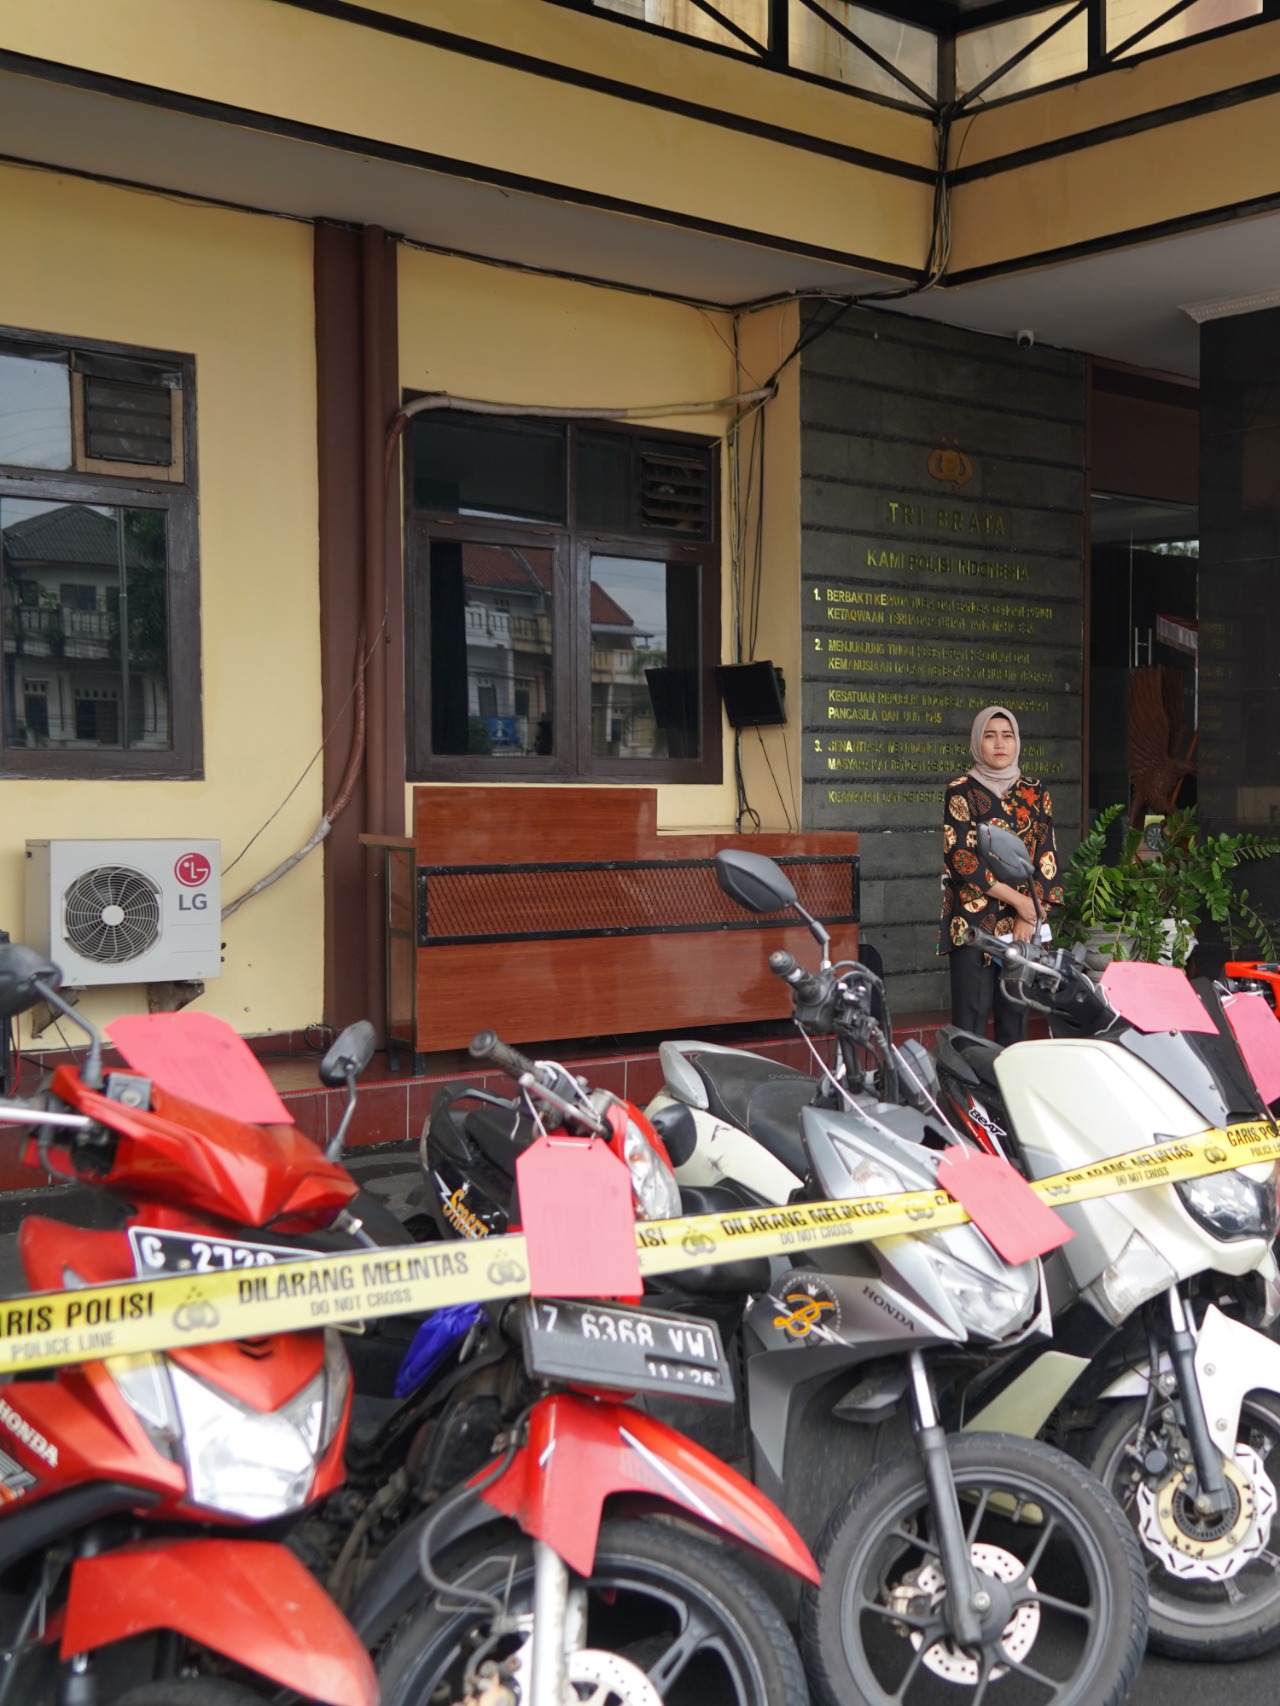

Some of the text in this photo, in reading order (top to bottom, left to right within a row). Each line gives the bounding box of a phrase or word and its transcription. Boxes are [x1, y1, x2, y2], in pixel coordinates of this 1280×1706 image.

[888, 501, 1006, 536] TRI BRATA
[866, 548, 1030, 581] KAMI POLISI INDONESIA
[813, 587, 821, 601] 1.
[826, 588, 873, 606] BERBAKTI
[827, 607, 884, 624] KETAQWAAN
[814, 638, 823, 651] 2.
[828, 639, 885, 655] MENJUNJUNG
[828, 657, 892, 673] KEMANUSIAAN
[828, 689, 875, 704] KESATUAN
[828, 706, 878, 722] PANCASILA
[881, 708, 899, 722] DAN
[814, 739, 823, 752] 3.
[828, 790, 880, 804] KEAMANAN
[178, 893, 208, 911] LG
[1226, 1127, 1261, 1147] GARIS
[1250, 1144, 1273, 1157] POLICE
[1115, 1166, 1169, 1186] DO NOT CROSS
[720, 1201, 890, 1236] DILARANG MELINTAS
[780, 1223, 853, 1245] DO NOT CROSS
[239, 1251, 469, 1305] DILARANG MELINTAS
[66, 1292, 154, 1328] POLISI
[310, 1288, 412, 1316] DO NOT CROSS
[862, 1285, 915, 1332] HONDA
[11, 1331, 115, 1362] POLICE LINE
